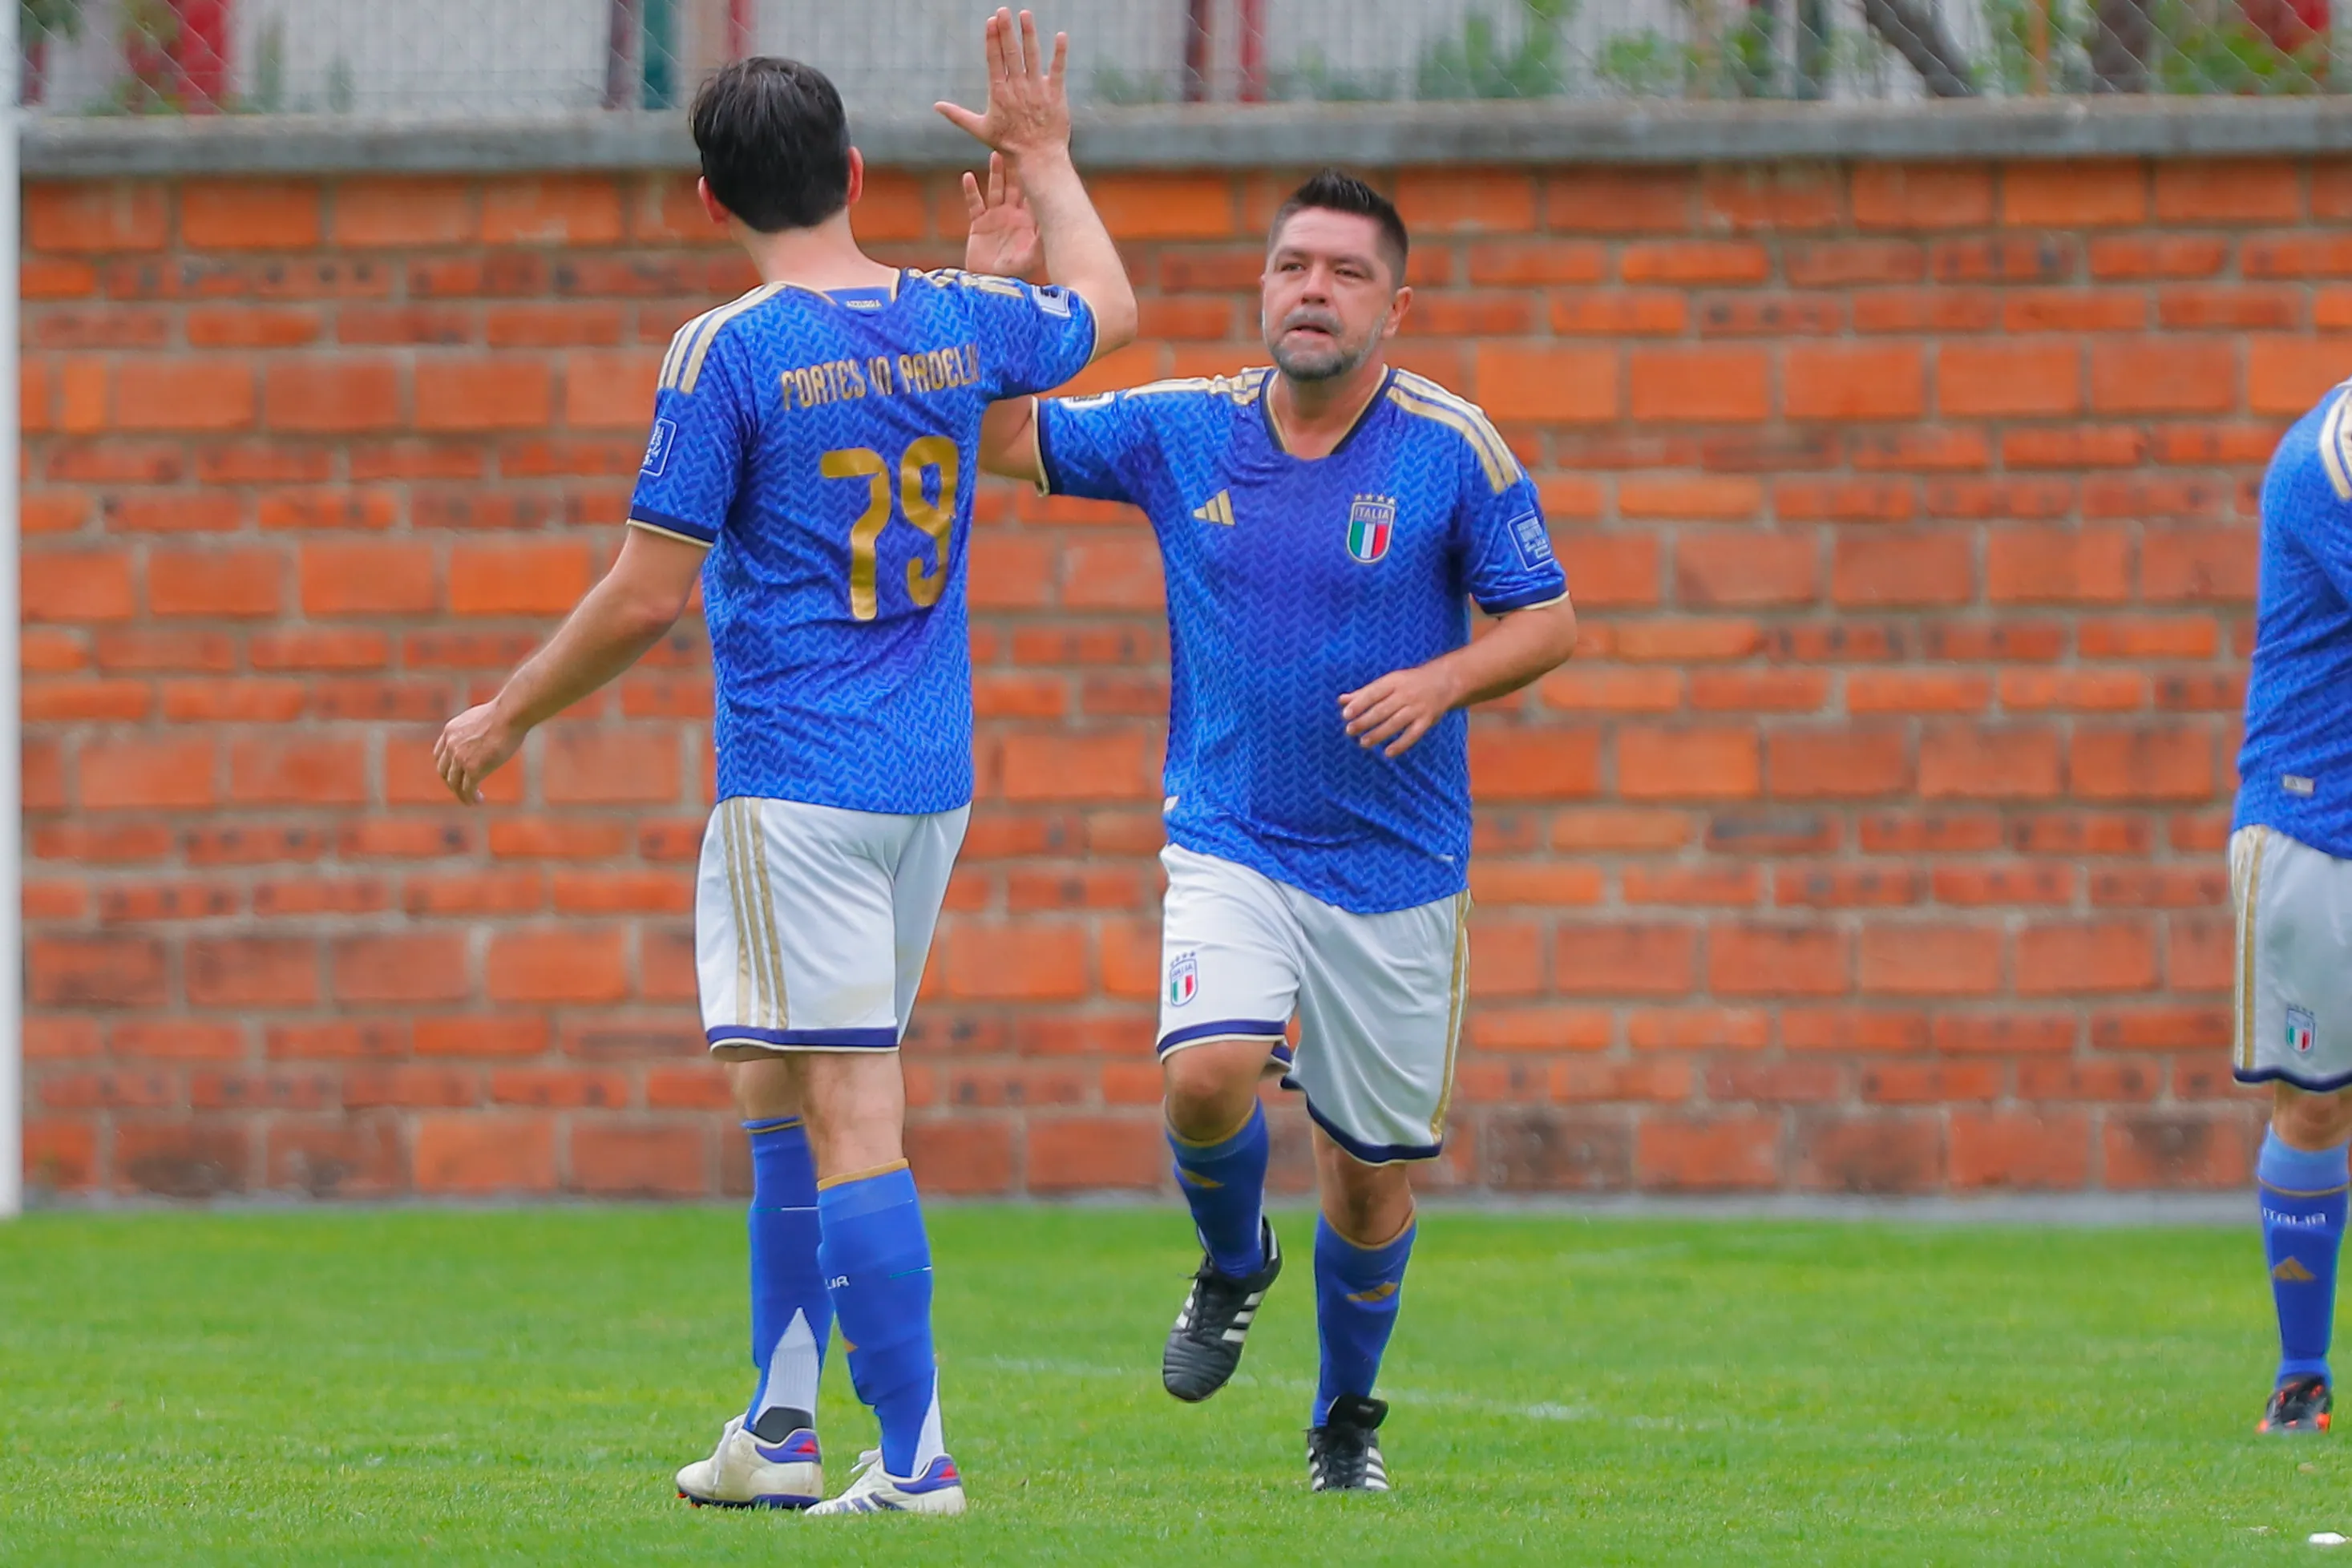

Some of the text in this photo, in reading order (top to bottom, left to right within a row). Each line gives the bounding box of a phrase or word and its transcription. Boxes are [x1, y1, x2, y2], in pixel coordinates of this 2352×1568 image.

[781, 358, 867, 410] FORTES
[820, 434, 960, 621] 79
[1355, 506, 1389, 519] ITALIA
